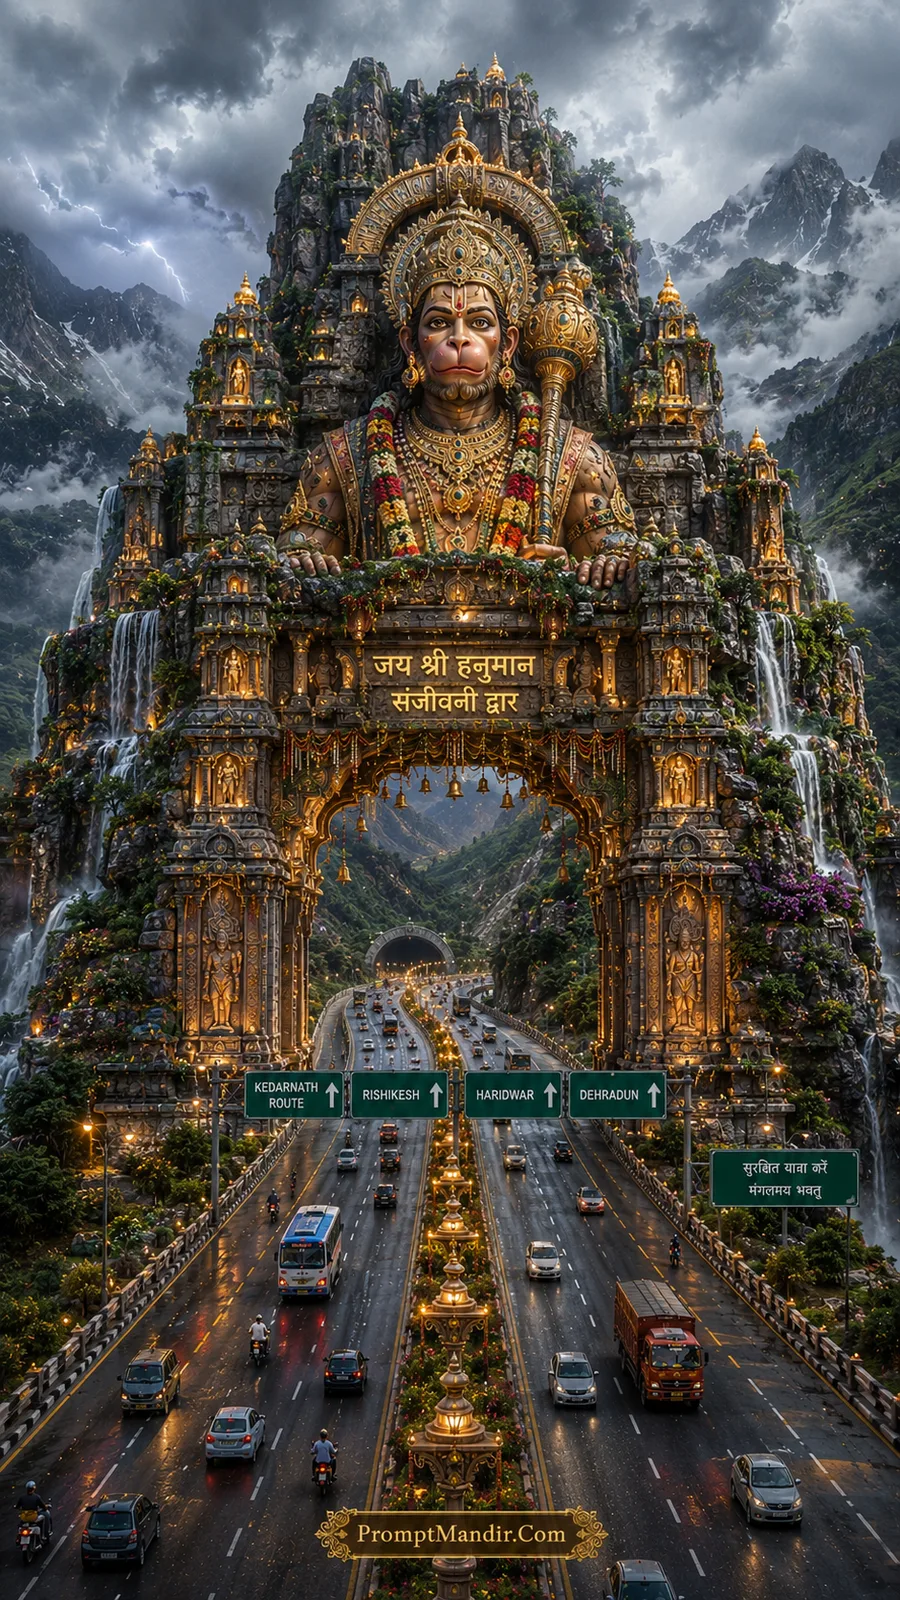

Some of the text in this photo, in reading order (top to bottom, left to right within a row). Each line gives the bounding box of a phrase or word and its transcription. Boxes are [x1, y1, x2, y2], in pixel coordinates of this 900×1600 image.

[372, 648, 536, 684] जय श्री हनुमान
[391, 685, 519, 715] संजीवनी द्वार
[254, 1082, 318, 1093] KEDARNATH
[362, 1089, 420, 1100] RISHIKESH
[476, 1089, 534, 1100] HARIDWAR
[579, 1089, 639, 1100] DEHRADUN
[269, 1098, 304, 1109] ROUTE
[749, 1183, 822, 1199] मंगलमय भवतु
